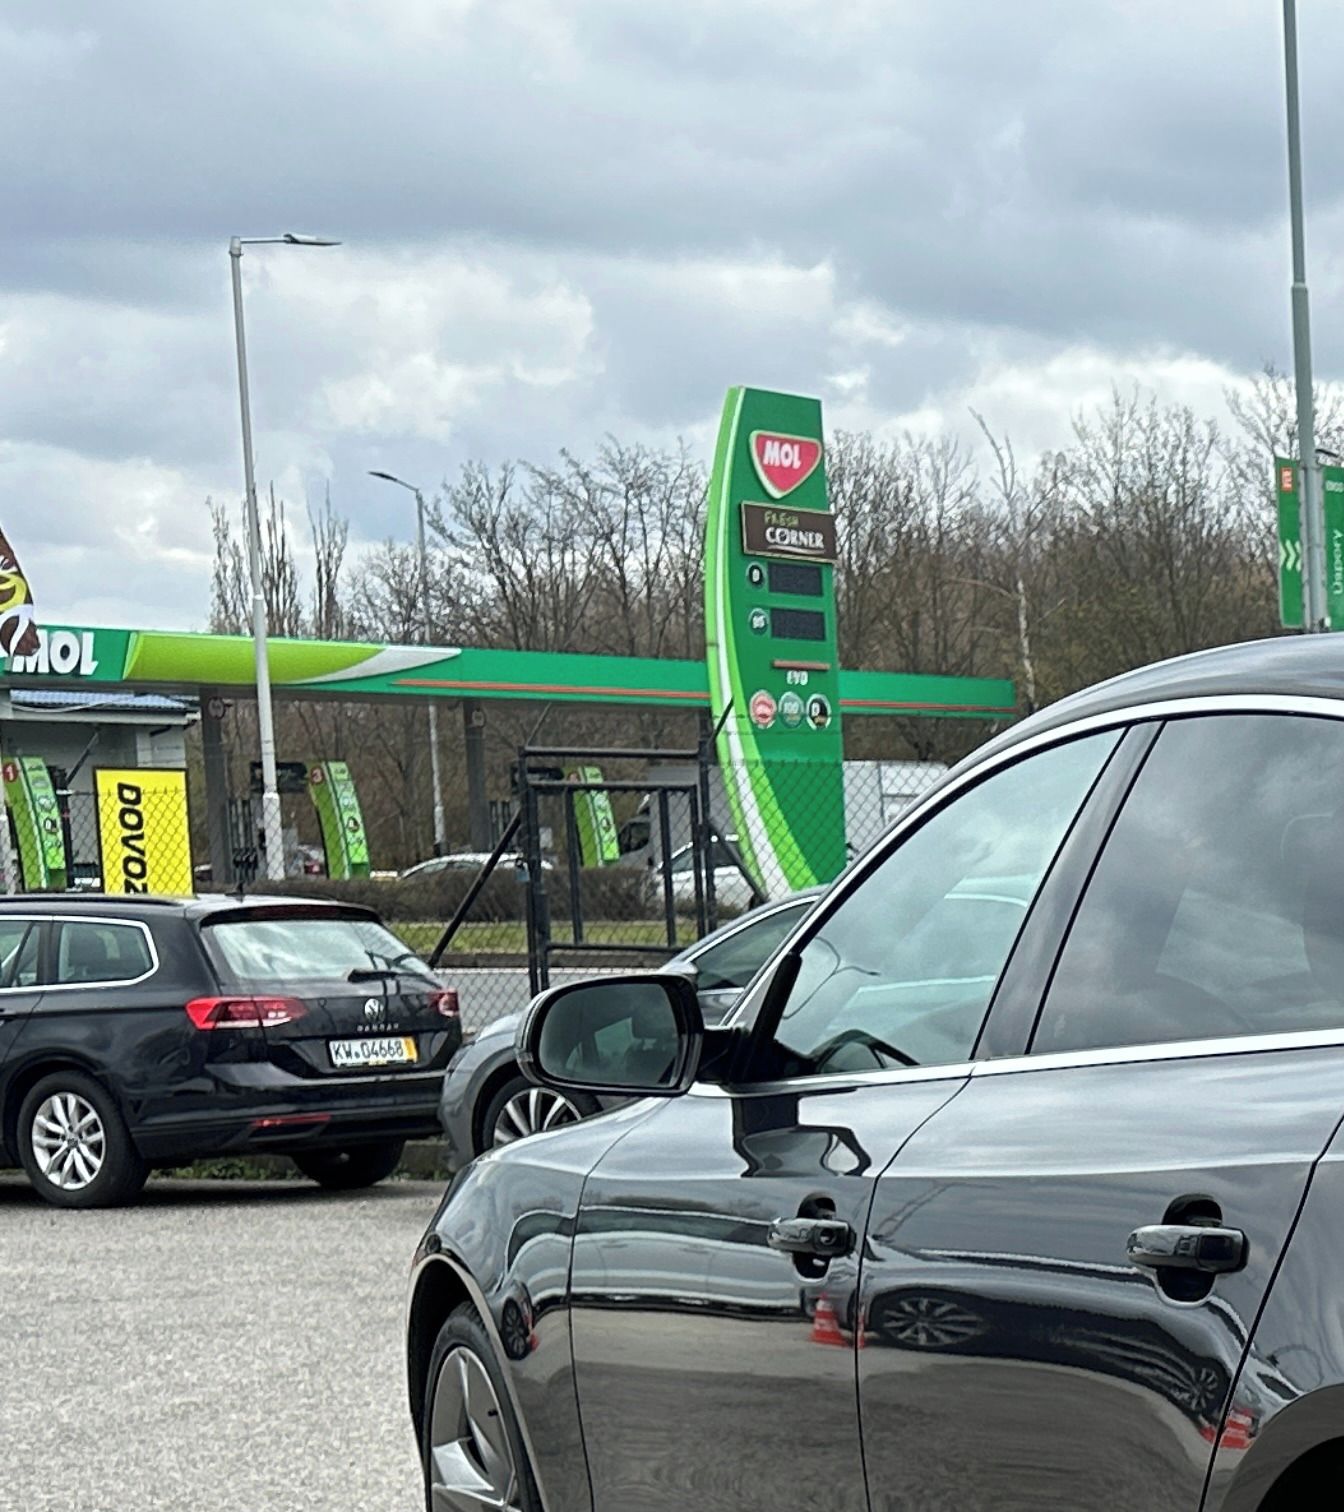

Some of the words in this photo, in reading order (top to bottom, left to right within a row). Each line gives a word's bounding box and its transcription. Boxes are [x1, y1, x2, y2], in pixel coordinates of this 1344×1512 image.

[763, 440, 802, 470] MOL
[764, 511, 799, 527] FRESH
[765, 526, 824, 549] CORNER
[12, 628, 99, 675] MOL
[786, 671, 809, 686] EVO
[333, 1043, 352, 1060] KW
[361, 1040, 403, 1058] 04668
